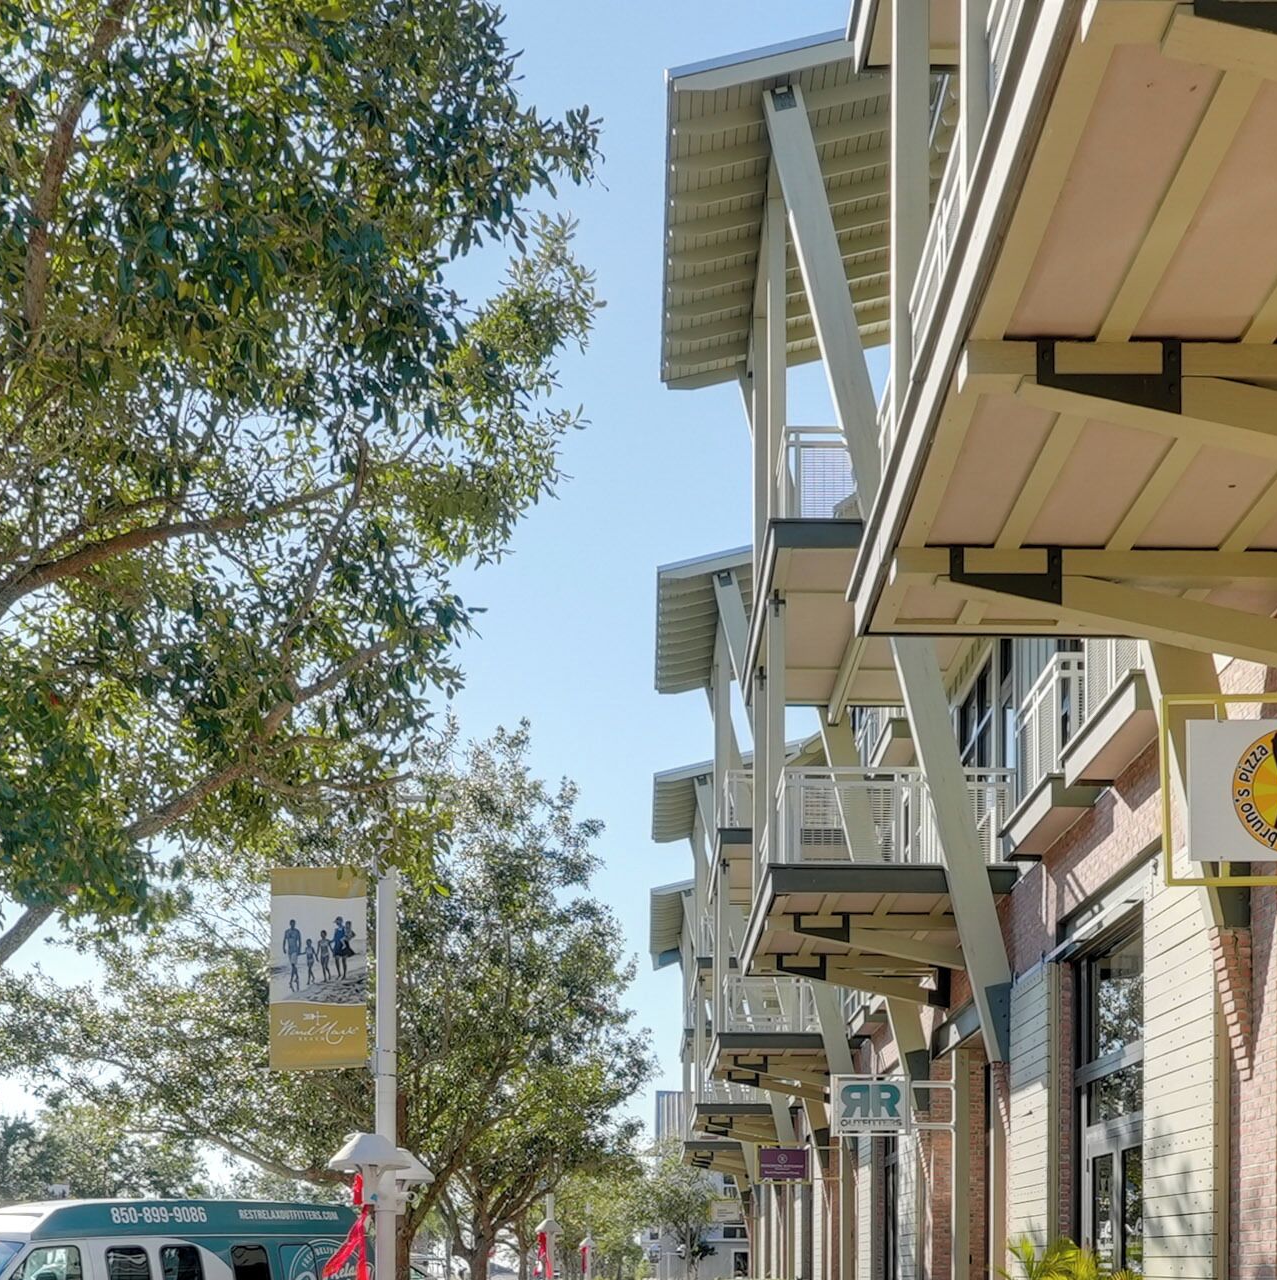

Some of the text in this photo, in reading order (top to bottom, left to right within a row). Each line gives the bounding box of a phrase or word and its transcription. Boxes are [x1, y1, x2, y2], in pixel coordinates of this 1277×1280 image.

[1238, 744, 1269, 783] pizza
[840, 1118, 903, 1127] OUTFITTERS
[110, 1206, 208, 1224] 850-899-9086
[238, 1208, 339, 1221] RESTRELAXOUTFITTERS.COM
